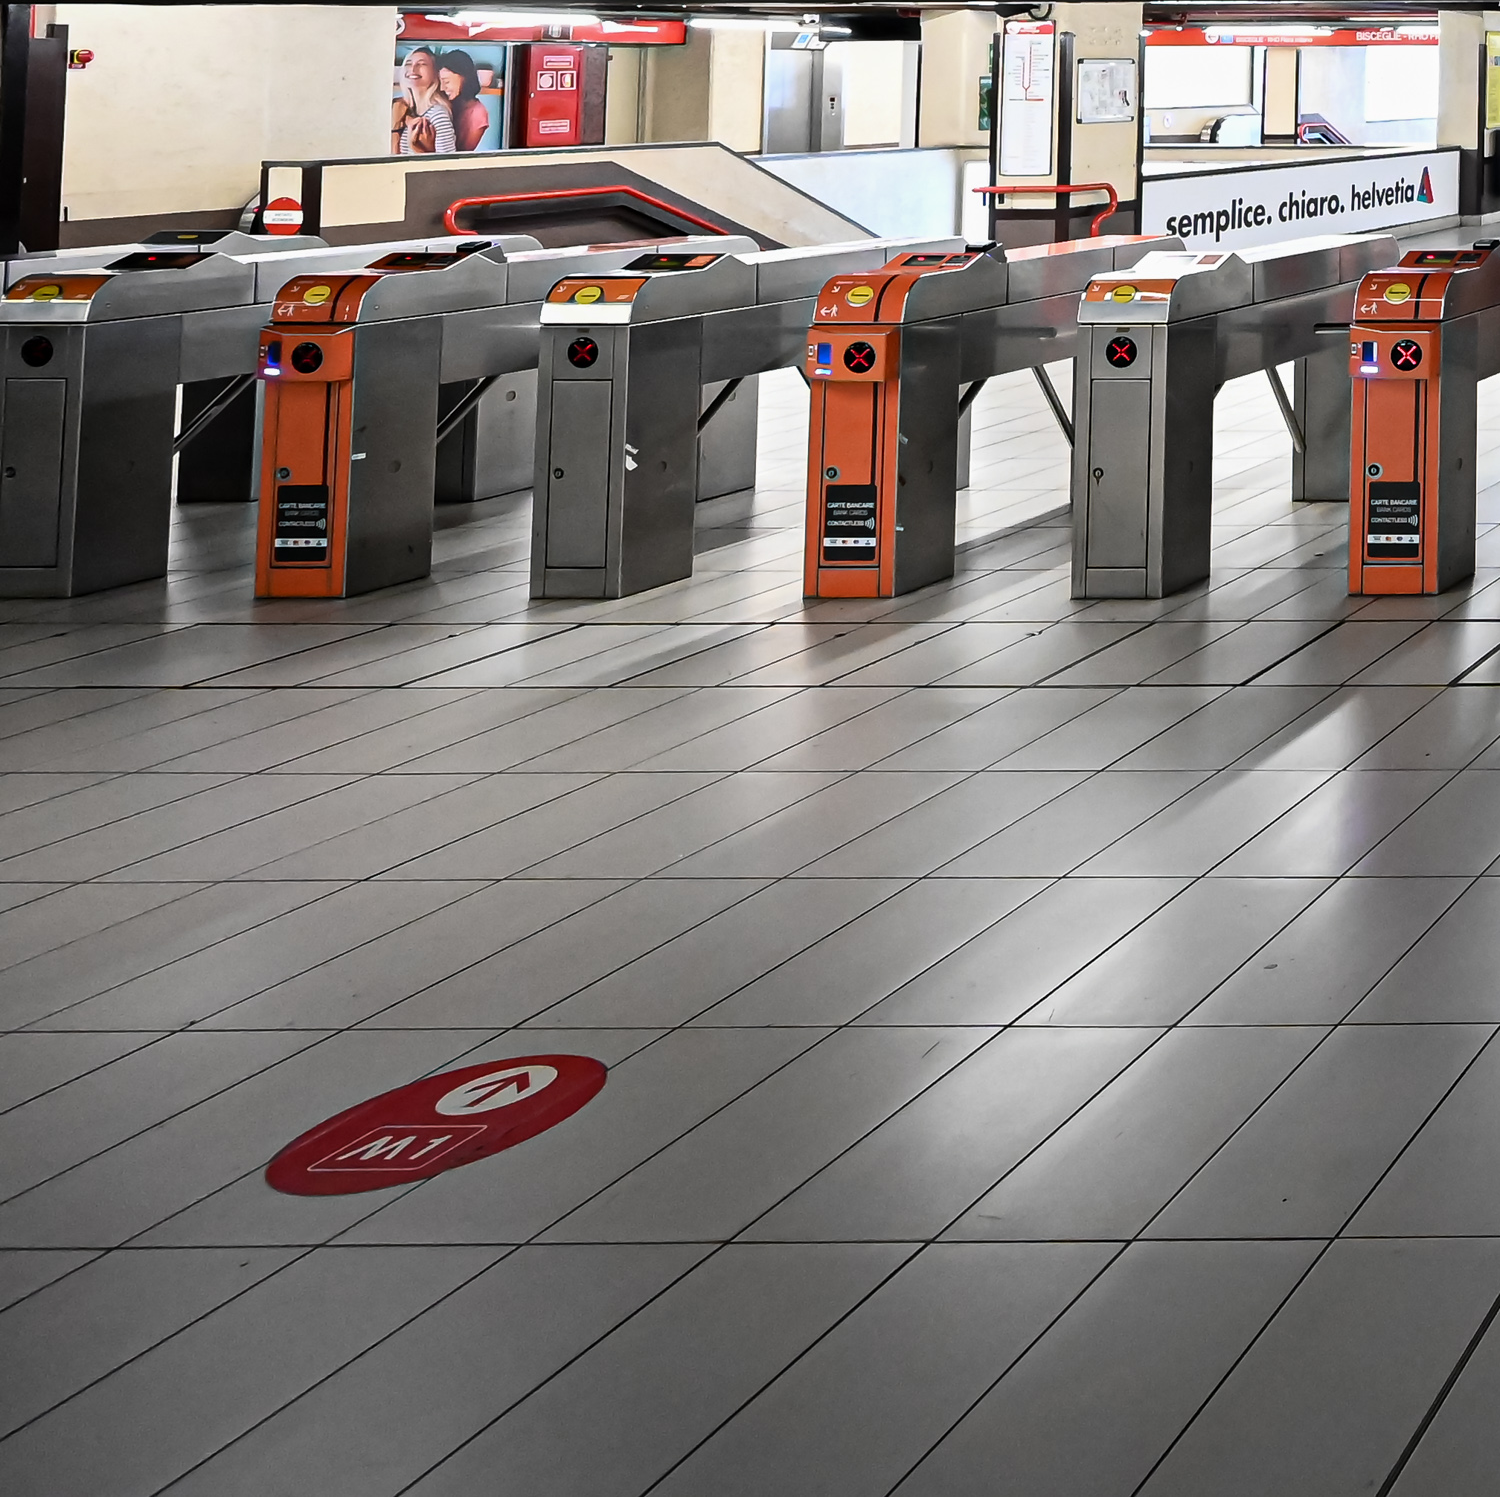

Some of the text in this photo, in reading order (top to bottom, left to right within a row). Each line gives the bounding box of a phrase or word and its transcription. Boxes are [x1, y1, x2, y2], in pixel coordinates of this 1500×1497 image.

[1166, 177, 1415, 242] semplice. chiaro. helvetia
[336, 1135, 453, 1160] M1
